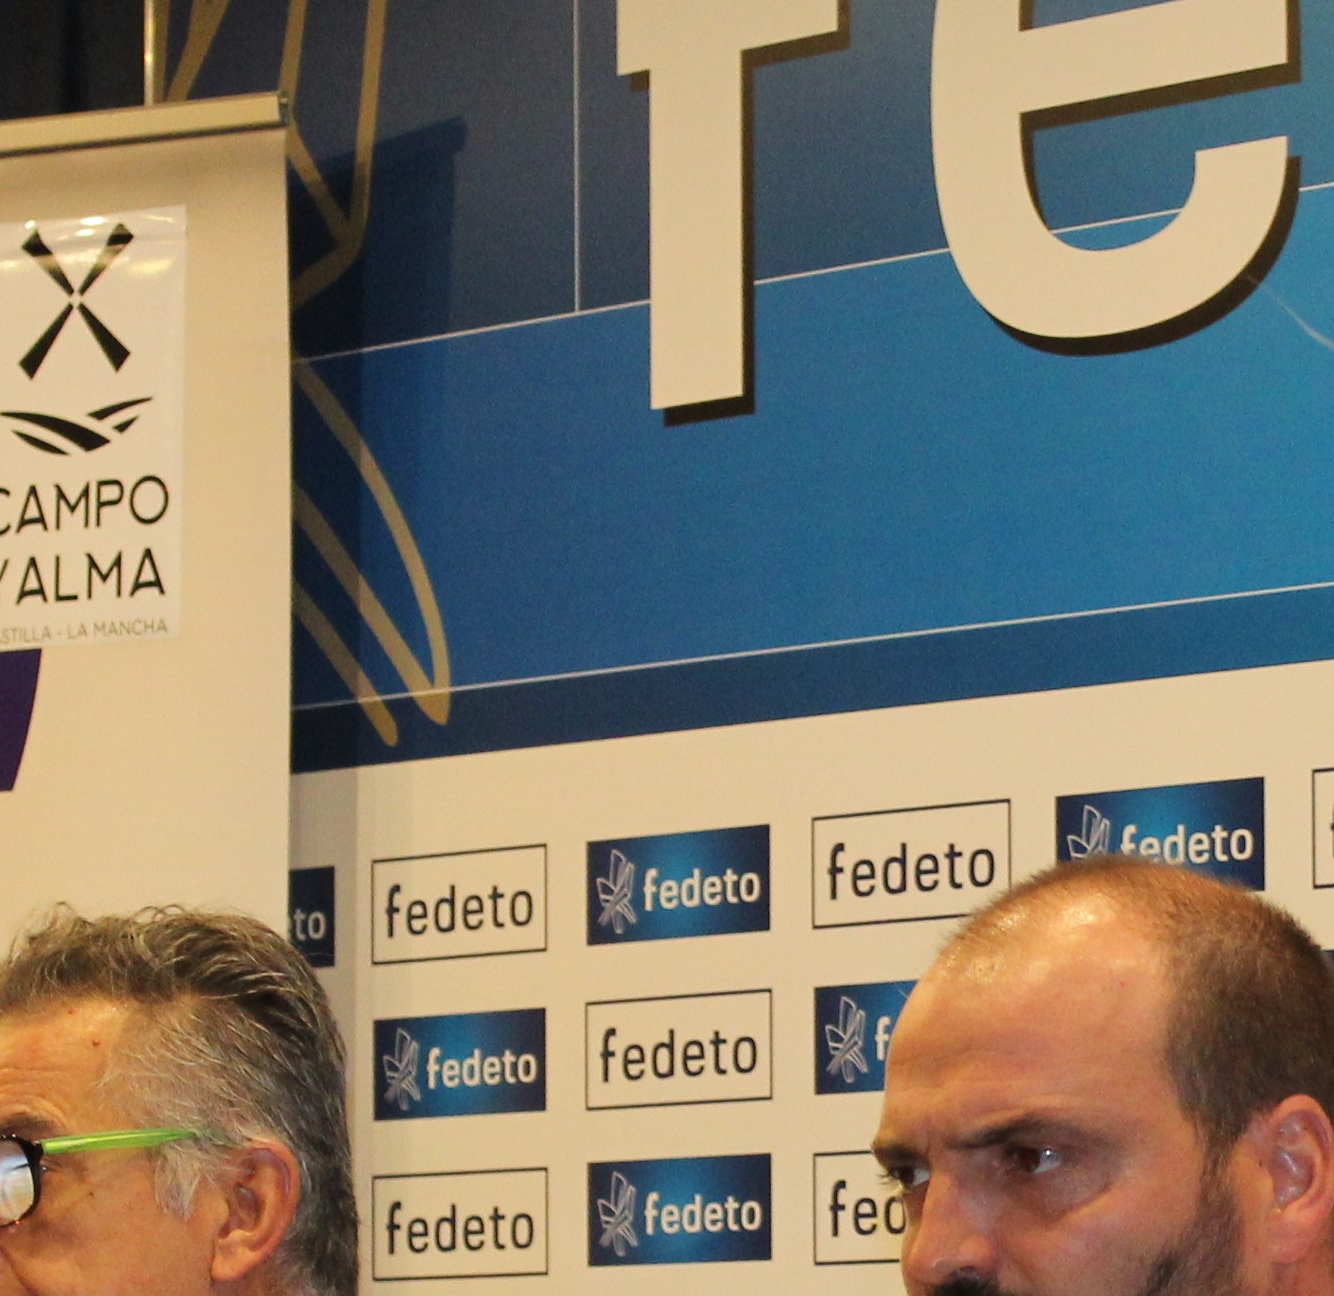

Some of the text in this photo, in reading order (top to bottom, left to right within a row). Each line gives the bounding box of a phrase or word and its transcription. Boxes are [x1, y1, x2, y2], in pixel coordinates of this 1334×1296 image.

[67, 623, 88, 639] LA
[93, 618, 168, 636] MANCHA
[642, 867, 761, 912] fedeto
[827, 842, 995, 901] fedeto
[385, 883, 533, 939] fedeto
[426, 1047, 537, 1090] fedeto
[600, 1027, 758, 1083] fedeto
[386, 1200, 534, 1255] fedeto
[643, 1191, 762, 1236] fedeto
